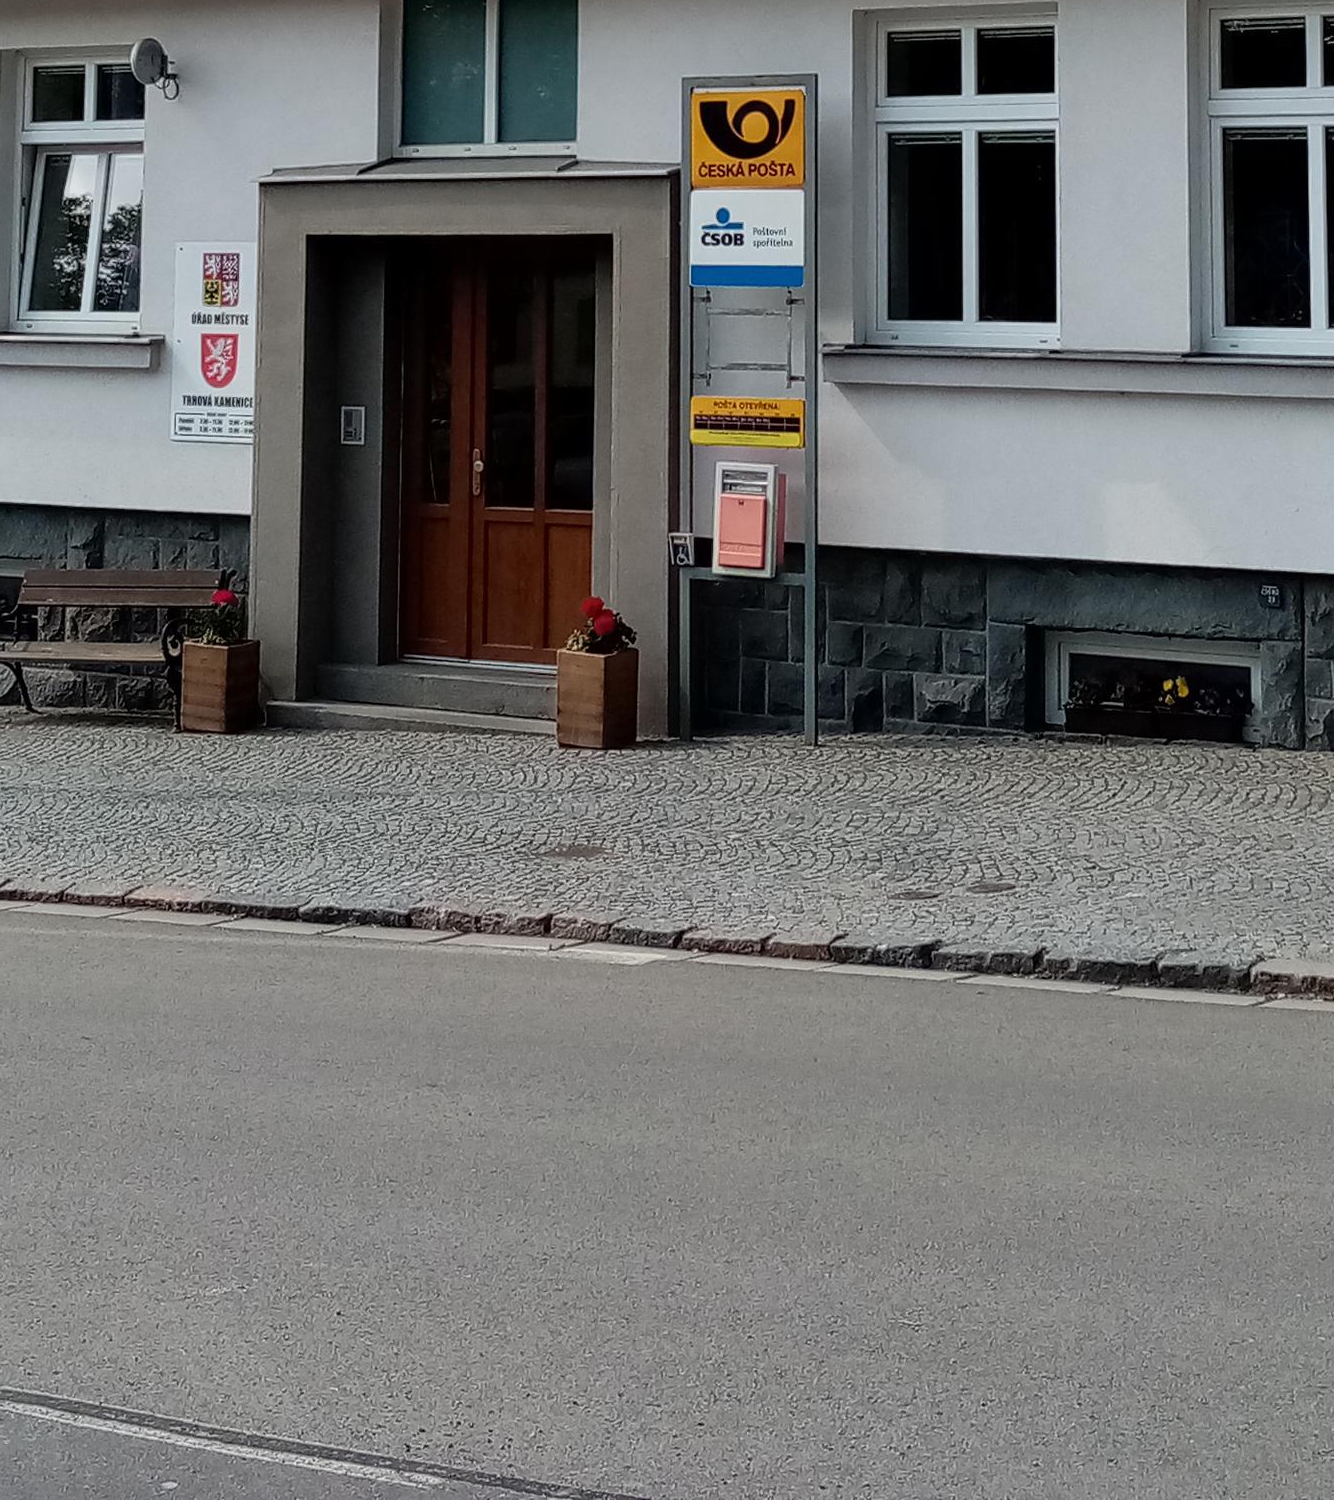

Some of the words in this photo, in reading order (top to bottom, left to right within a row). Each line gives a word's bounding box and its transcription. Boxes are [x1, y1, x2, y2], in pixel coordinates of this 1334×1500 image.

[698, 161, 745, 178] ČESKÁ
[748, 160, 796, 177] POŠTA
[701, 231, 744, 247] ČSOB
[752, 227, 788, 237] Poštovní
[752, 238, 794, 249] spořitelna
[191, 311, 213, 325] ÚŘAD
[214, 311, 249, 326] MĚSTYSE
[214, 395, 253, 408] KAMENICE
